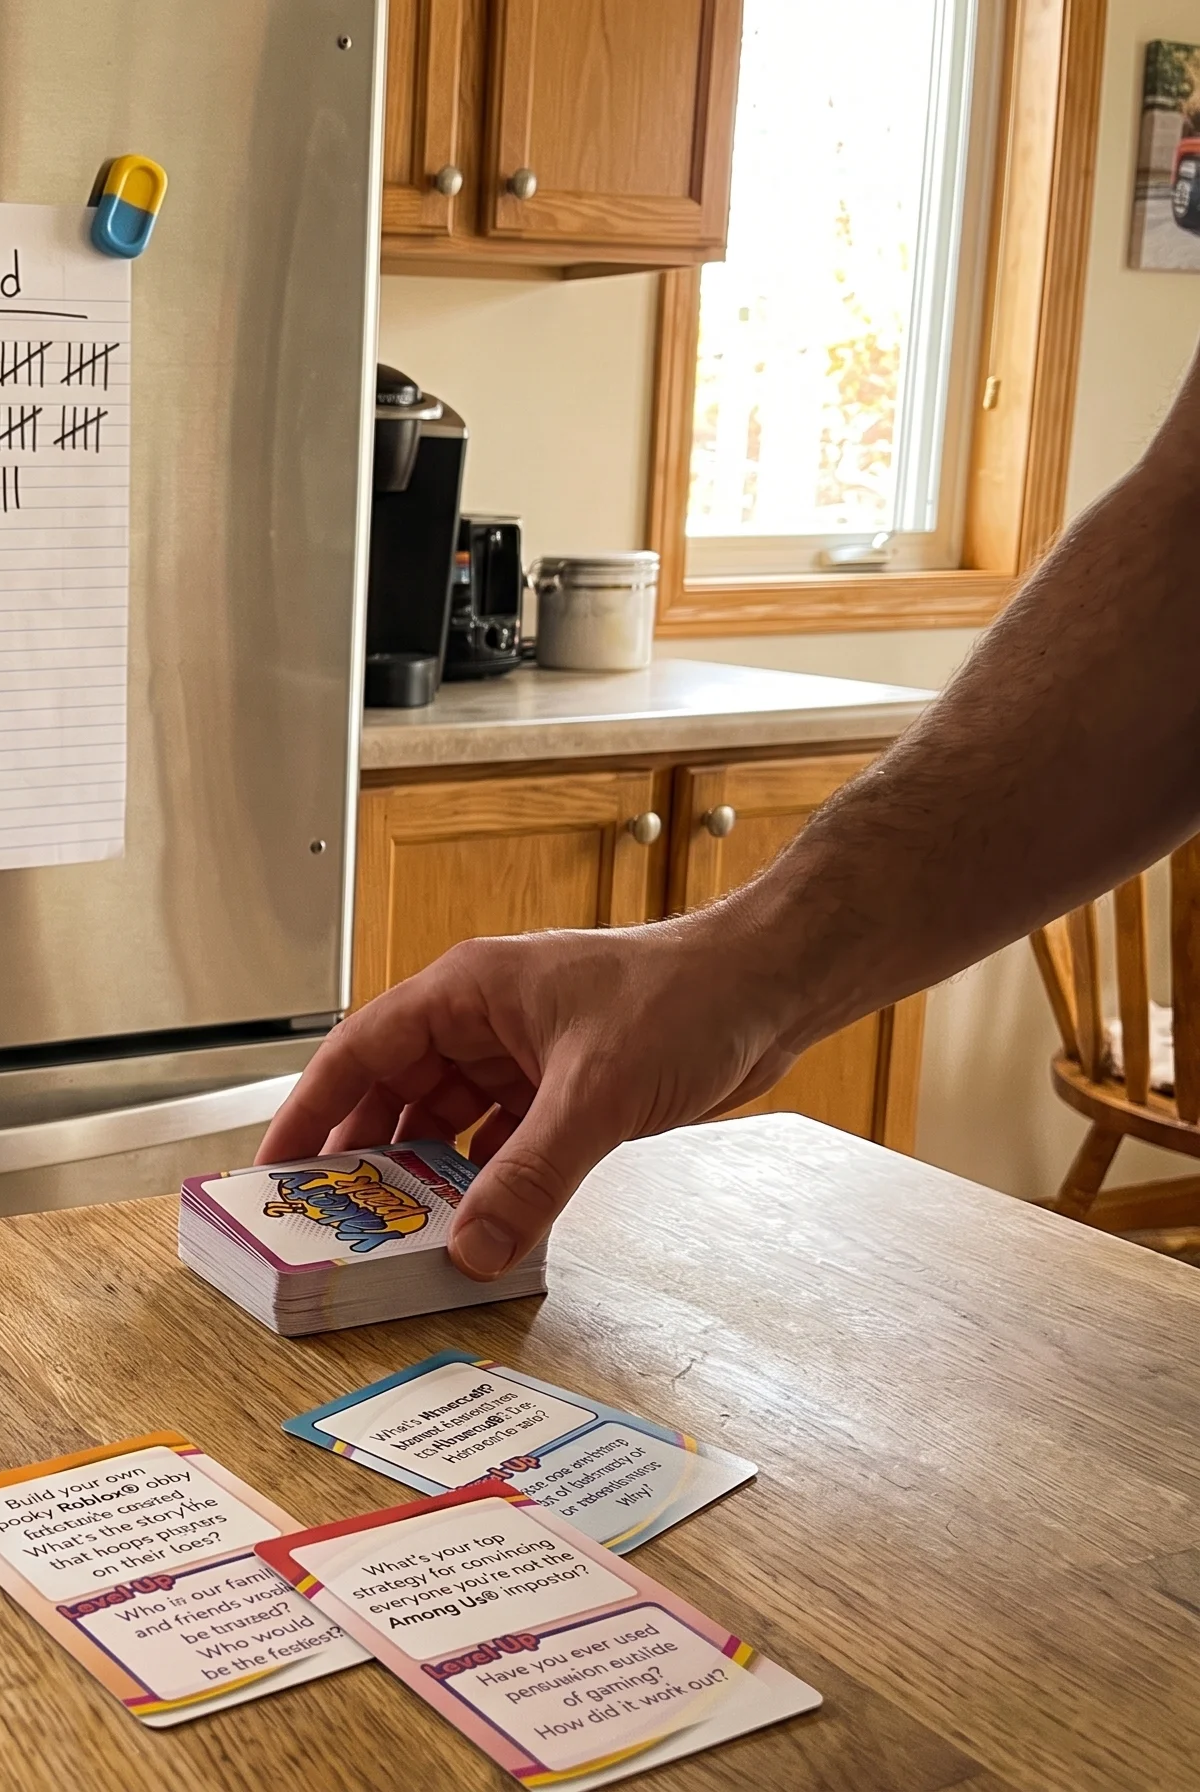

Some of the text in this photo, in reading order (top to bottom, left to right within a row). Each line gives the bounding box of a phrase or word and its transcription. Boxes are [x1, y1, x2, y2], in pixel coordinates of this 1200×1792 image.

[4, 1467, 146, 1511] Build your own
[146, 1471, 192, 1490] obby
[22, 1533, 98, 1559] What's
[99, 1521, 132, 1537] the
[50, 1551, 93, 1570] that
[93, 1535, 154, 1558] hoops
[361, 1533, 506, 1576] What's your top
[92, 1564, 119, 1578] on
[120, 1550, 166, 1569] their
[353, 1539, 555, 1600] strategy for convincing
[369, 1551, 575, 1614] everyone you're not the
[114, 1603, 166, 1622] Who
[190, 1584, 222, 1601] our
[134, 1620, 172, 1639] and
[174, 1601, 242, 1626] friends
[388, 1603, 461, 1629] Among
[180, 1630, 211, 1644] be
[196, 1615, 314, 1660] Who would
[475, 1623, 660, 1687] Have you ever used
[201, 1665, 232, 1680] be
[231, 1653, 268, 1671] the
[534, 1718, 584, 1740] How
[588, 1705, 619, 1724] did
[618, 1698, 639, 1713] it
[688, 1668, 728, 1692] out?
[563, 1692, 582, 1707] of
